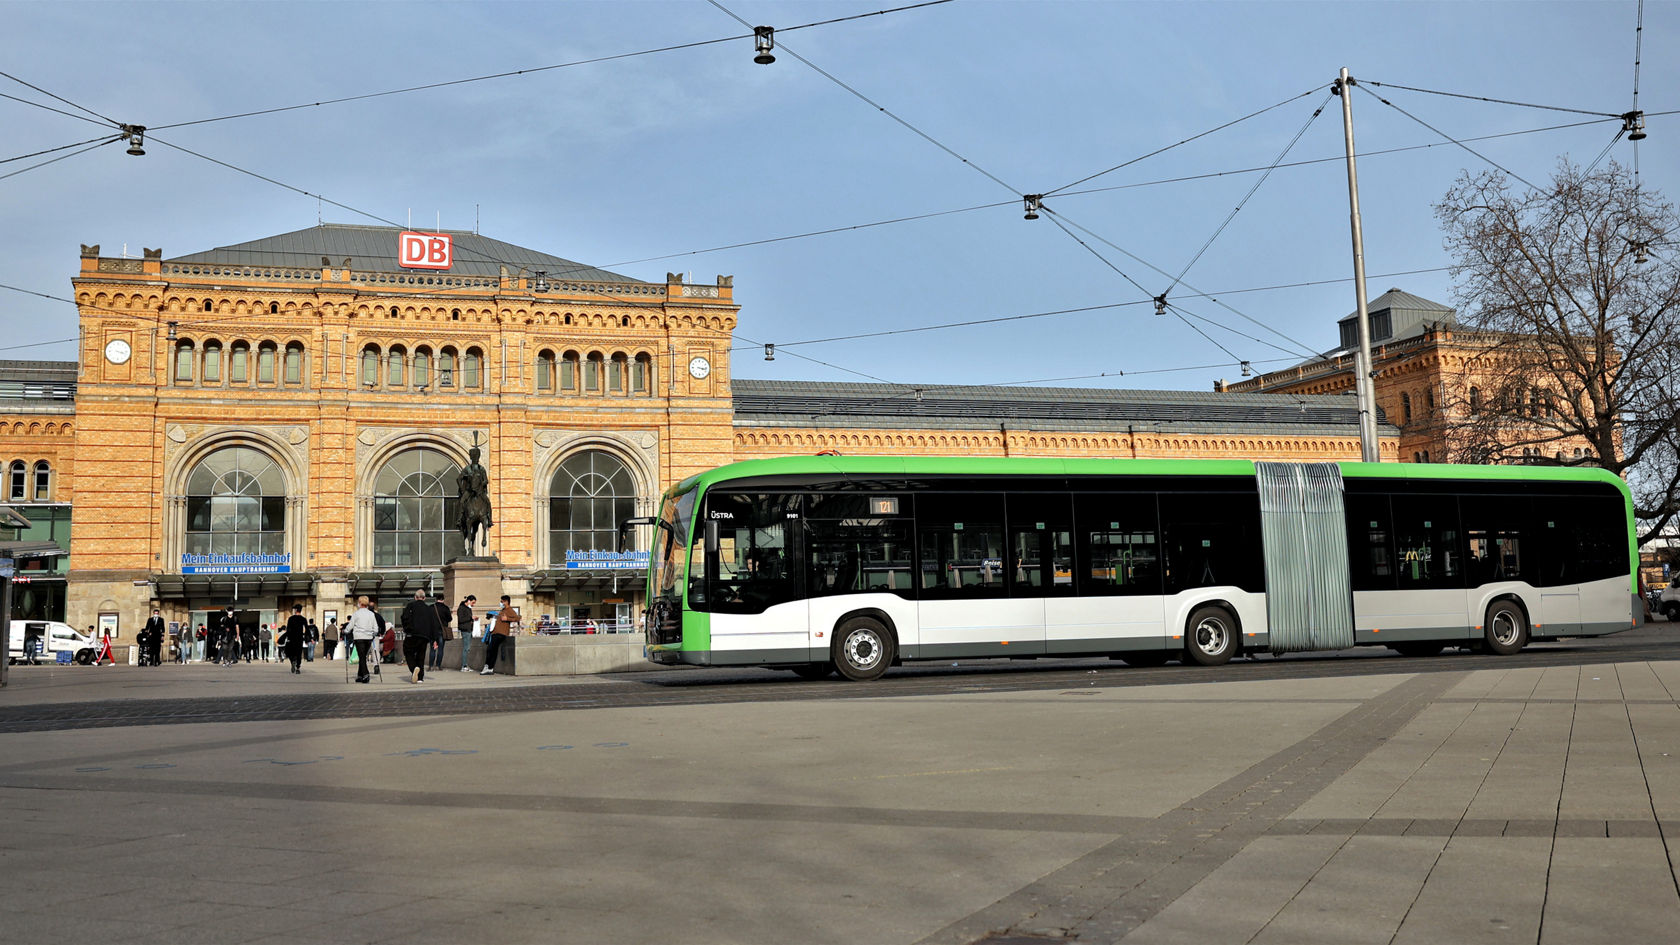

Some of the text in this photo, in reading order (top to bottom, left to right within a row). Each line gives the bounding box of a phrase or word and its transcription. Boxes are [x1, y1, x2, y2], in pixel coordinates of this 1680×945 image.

[406, 238, 446, 262] DB
[711, 511, 734, 519] ÜSTRA
[181, 552, 291, 564] Mein Einkaufsbahnhof
[566, 549, 588, 560] Mein
